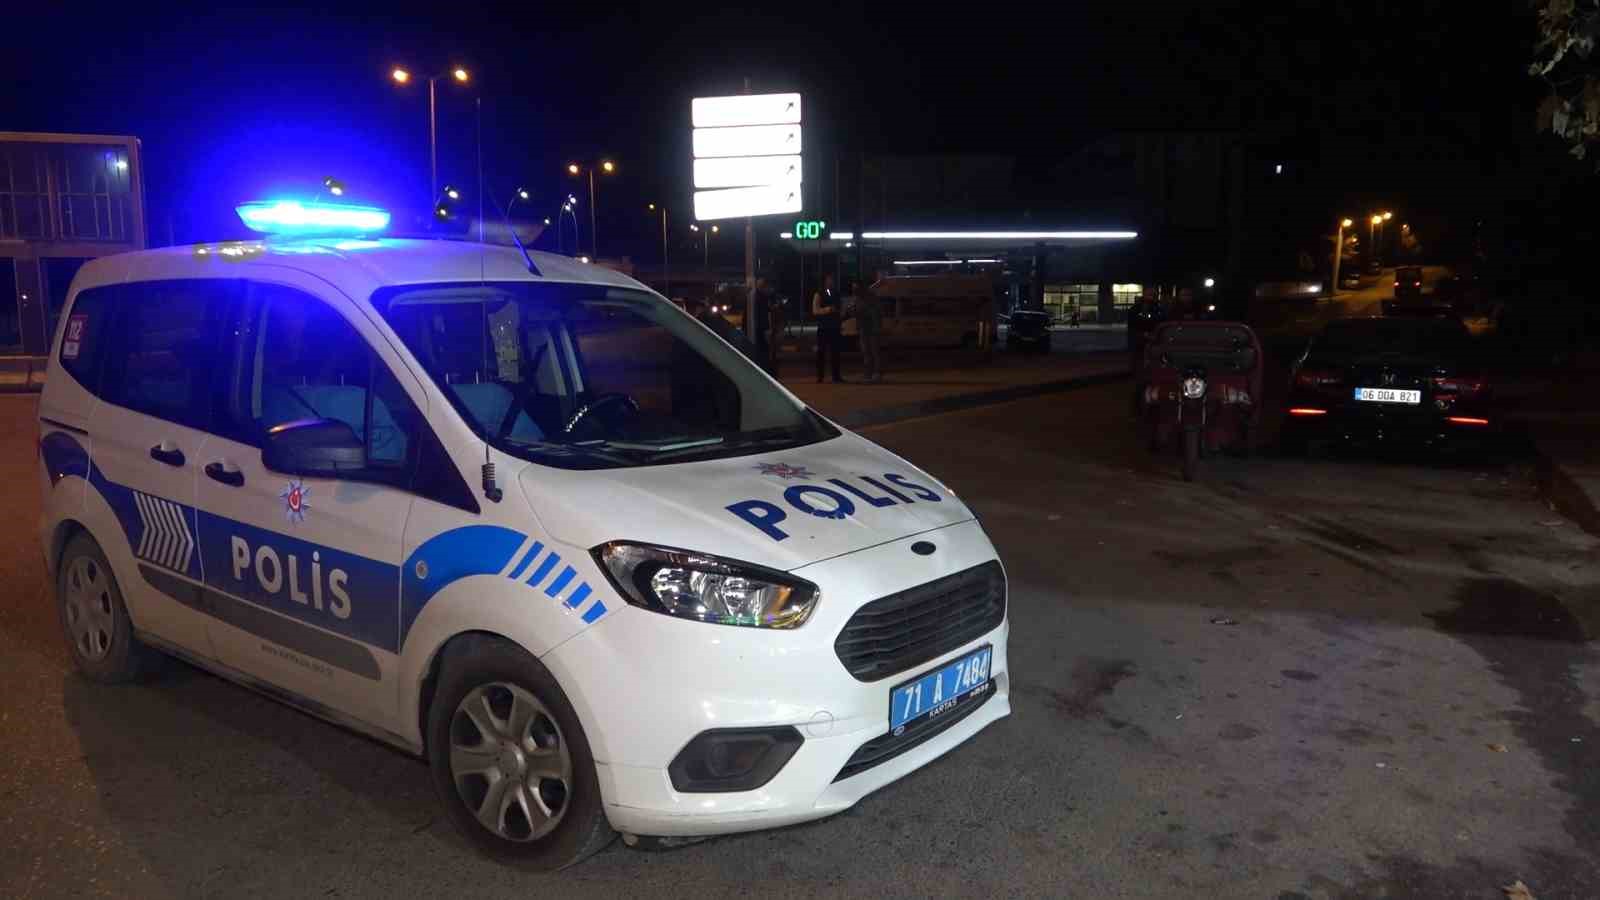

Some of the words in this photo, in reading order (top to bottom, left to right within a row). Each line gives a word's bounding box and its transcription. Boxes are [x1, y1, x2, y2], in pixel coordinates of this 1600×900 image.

[1362, 390, 1375, 400] 06
[1400, 391, 1417, 401] 821
[231, 535, 352, 620] POLİS
[903, 683, 922, 720] 71
[933, 672, 943, 704] A
